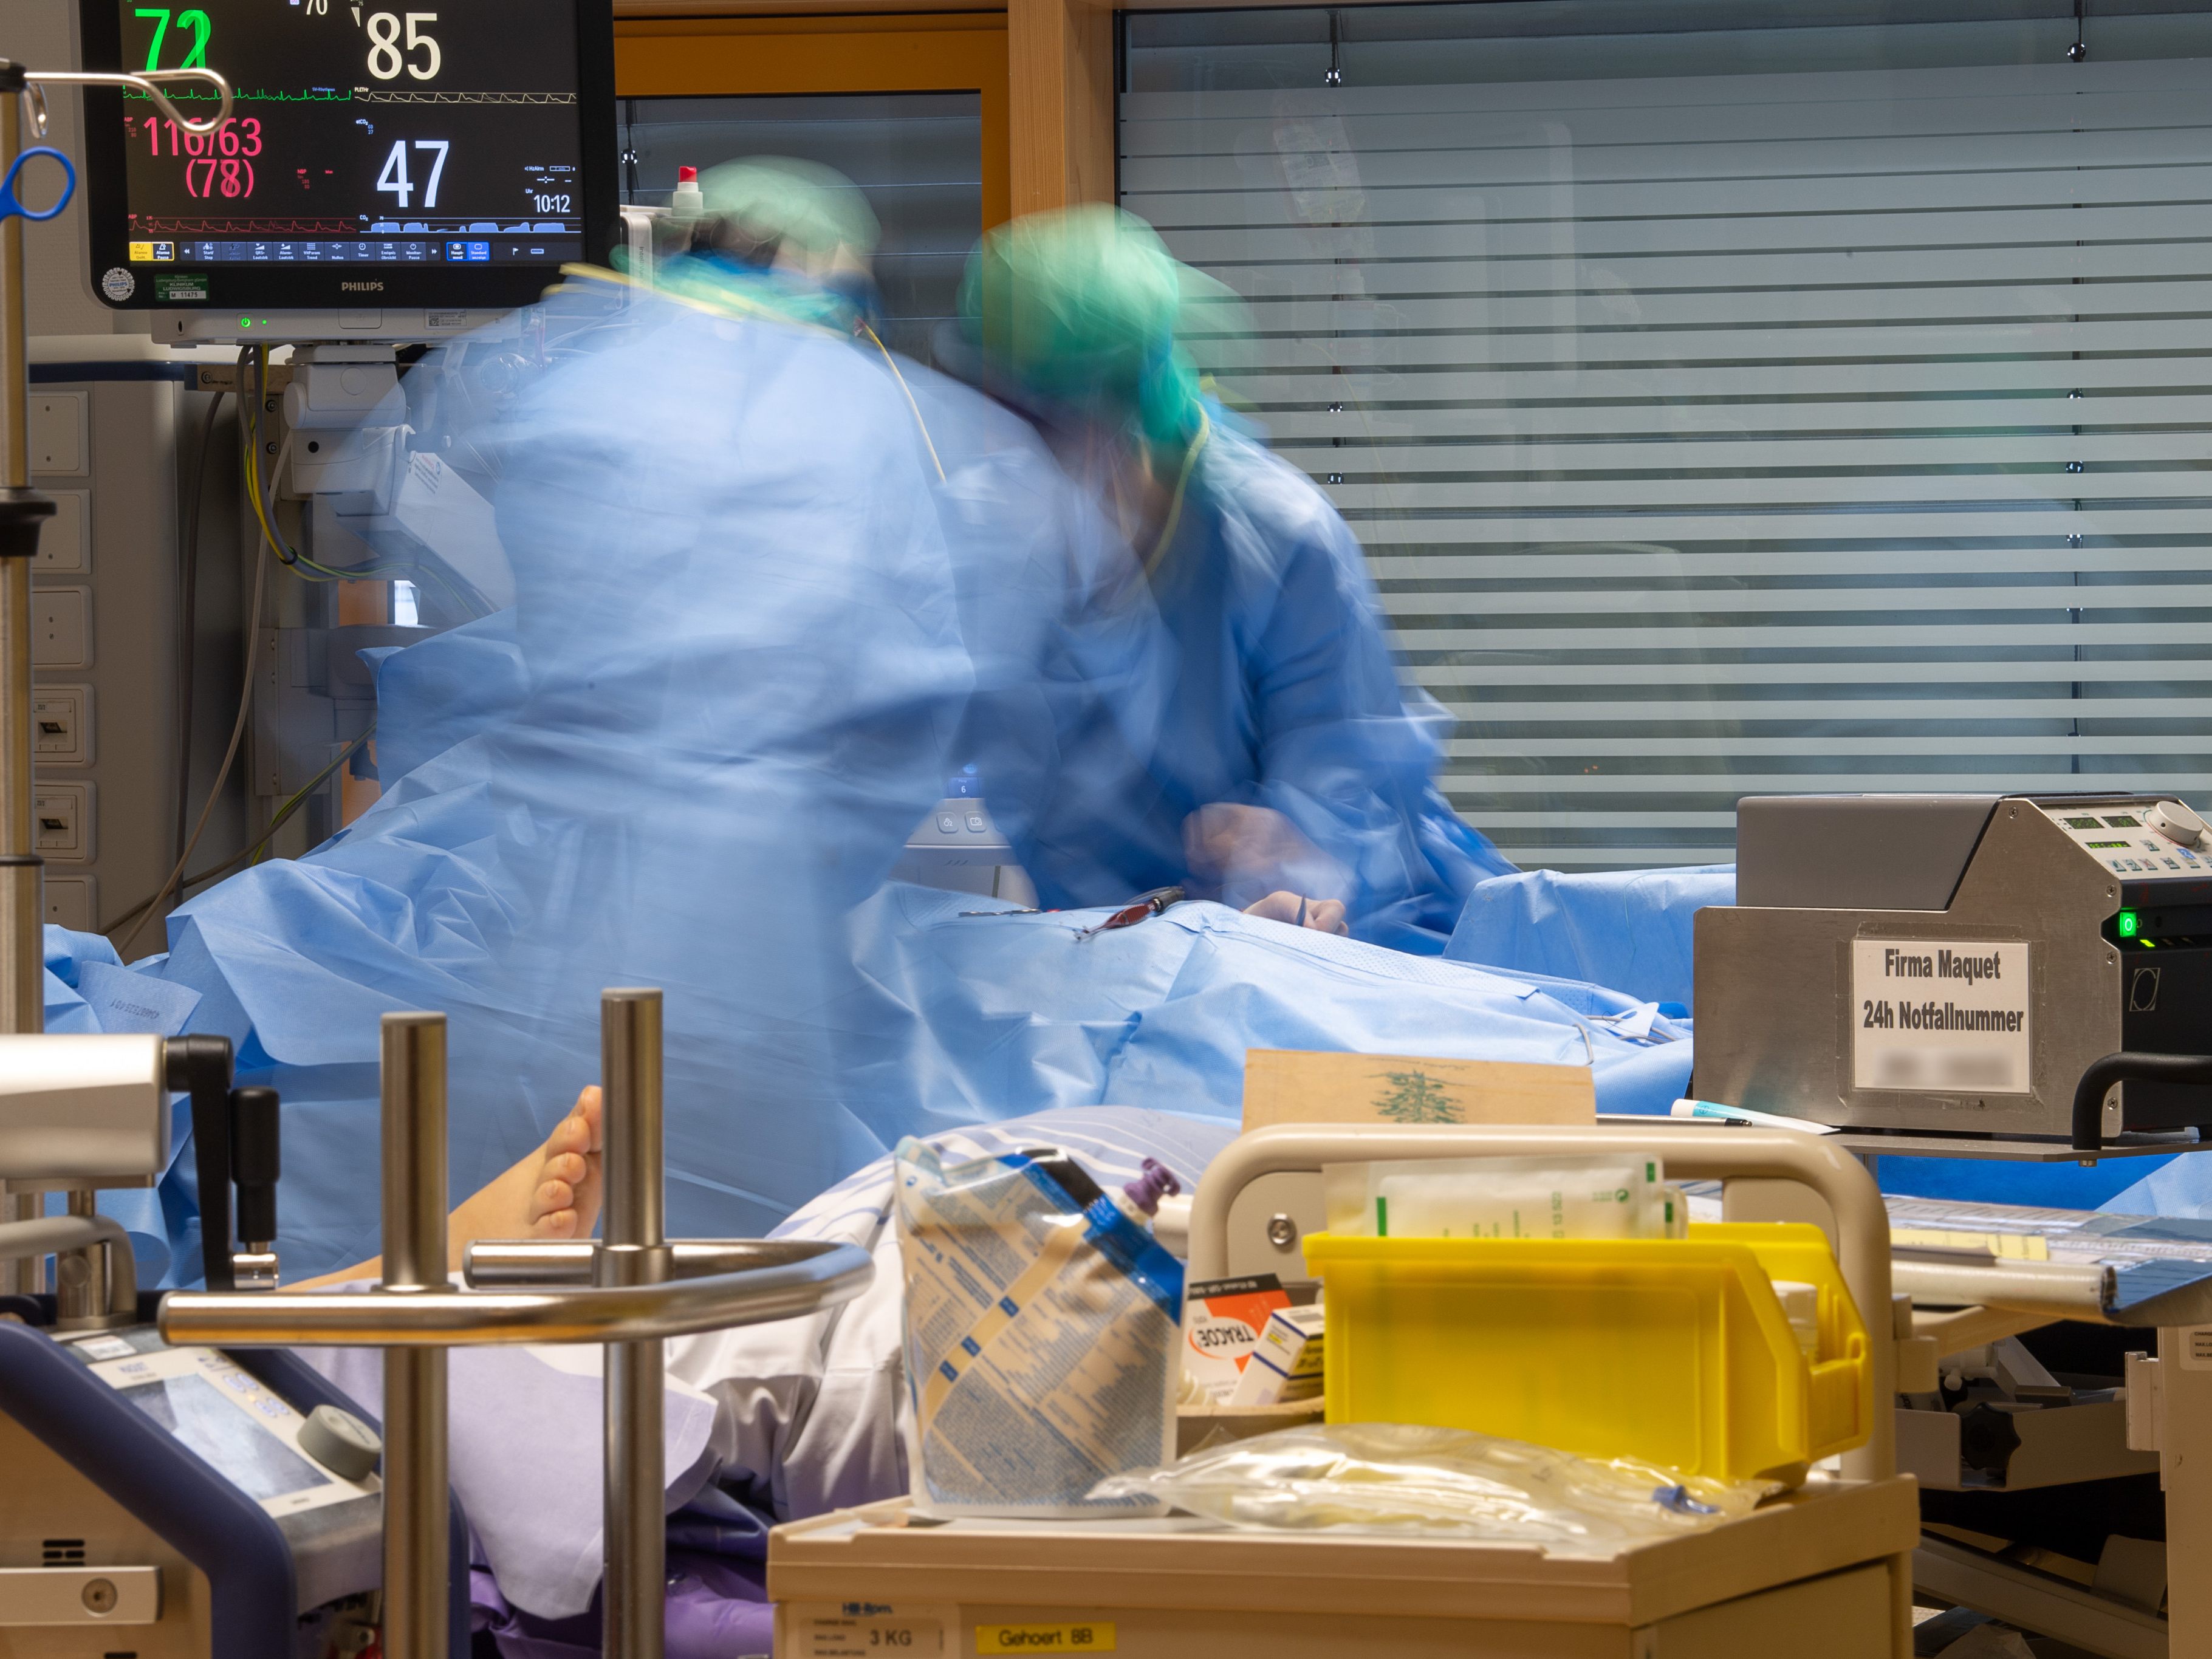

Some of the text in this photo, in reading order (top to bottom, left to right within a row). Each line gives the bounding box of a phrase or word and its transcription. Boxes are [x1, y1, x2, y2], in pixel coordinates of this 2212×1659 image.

[367, 12, 441, 80] 85
[143, 116, 262, 156] 116/63
[377, 140, 450, 208] 47
[533, 194, 570, 213] 10:12
[341, 282, 384, 291] PHILIPS
[1885, 948, 2001, 986] Firma Maquet
[1863, 1000, 2024, 1032] 24h Notfallnummer
[1197, 1324, 1255, 1348] TRACOE
[870, 1629, 912, 1646] 3 KG
[998, 1629, 1062, 1647] Gehoert
